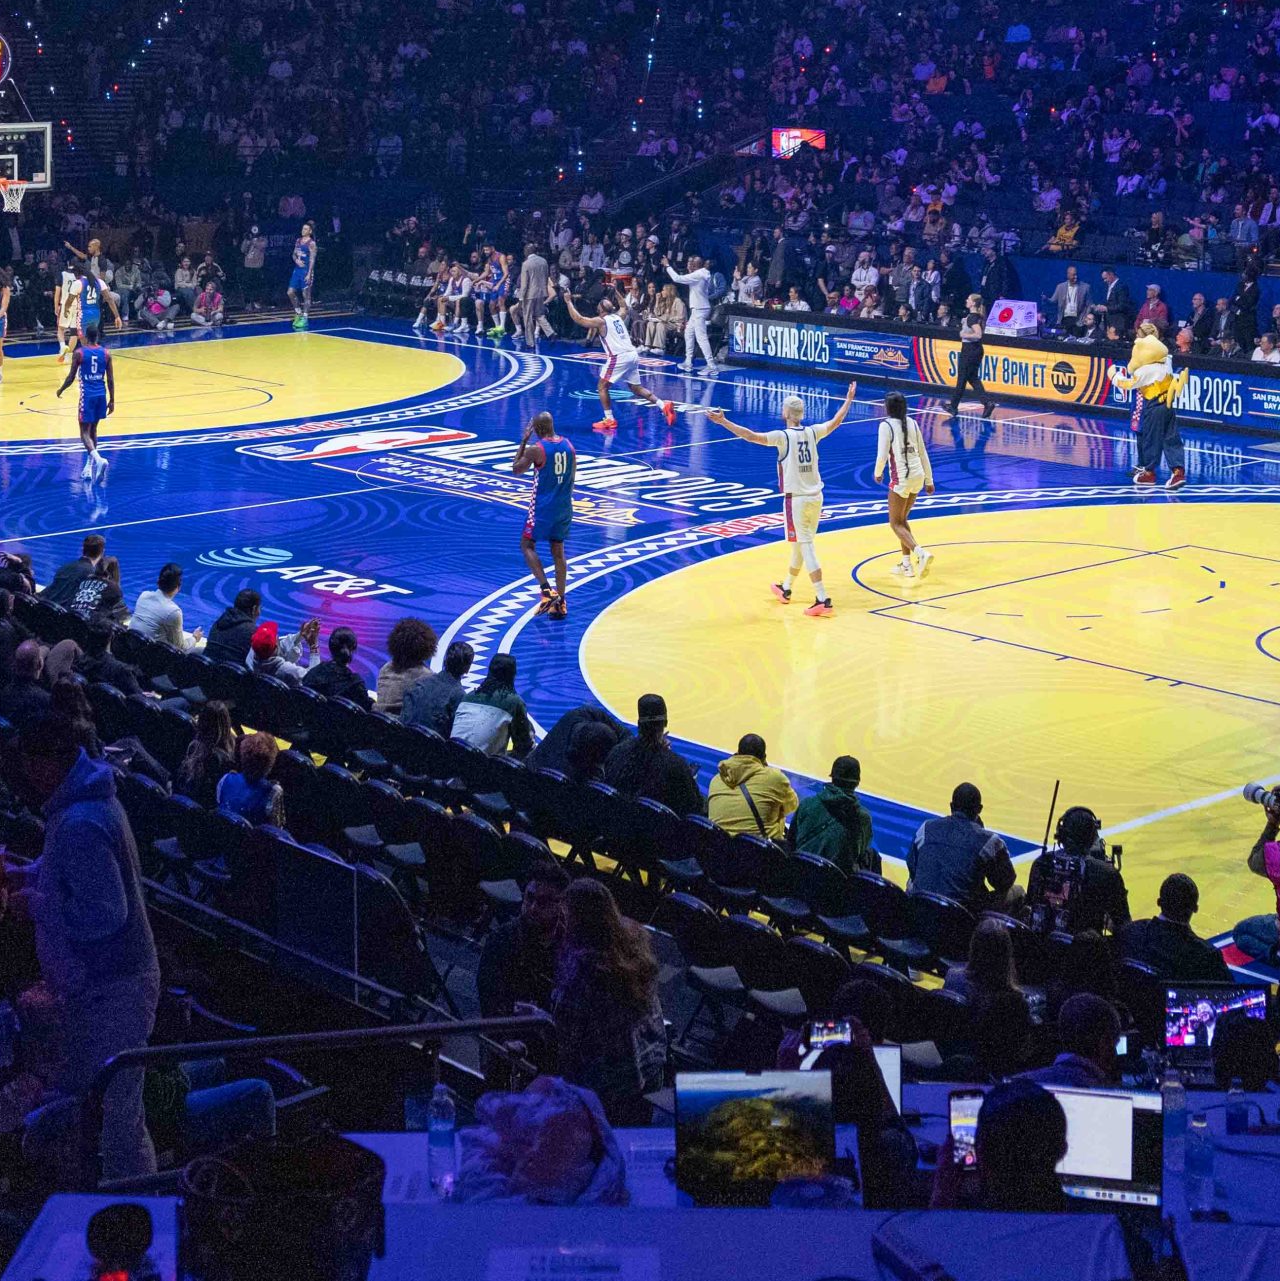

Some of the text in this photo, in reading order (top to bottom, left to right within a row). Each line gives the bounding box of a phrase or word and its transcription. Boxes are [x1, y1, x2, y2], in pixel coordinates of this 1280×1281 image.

[87, 287, 97, 299] 24
[800, 330, 829, 363] 2025
[848, 343, 878, 353] FRANCISCO
[91, 356, 98, 373] 5
[1002, 357, 1028, 386] 8PM
[1033, 364, 1046, 388] ET
[1051, 372, 1076, 388] TNT
[1204, 377, 1242, 417] 2025
[1252, 392, 1266, 401] SAN
[1264, 402, 1276, 410] BAY
[797, 441, 812, 463] 33
[554, 451, 567, 475] 81
[255, 565, 414, 599] AT&T
